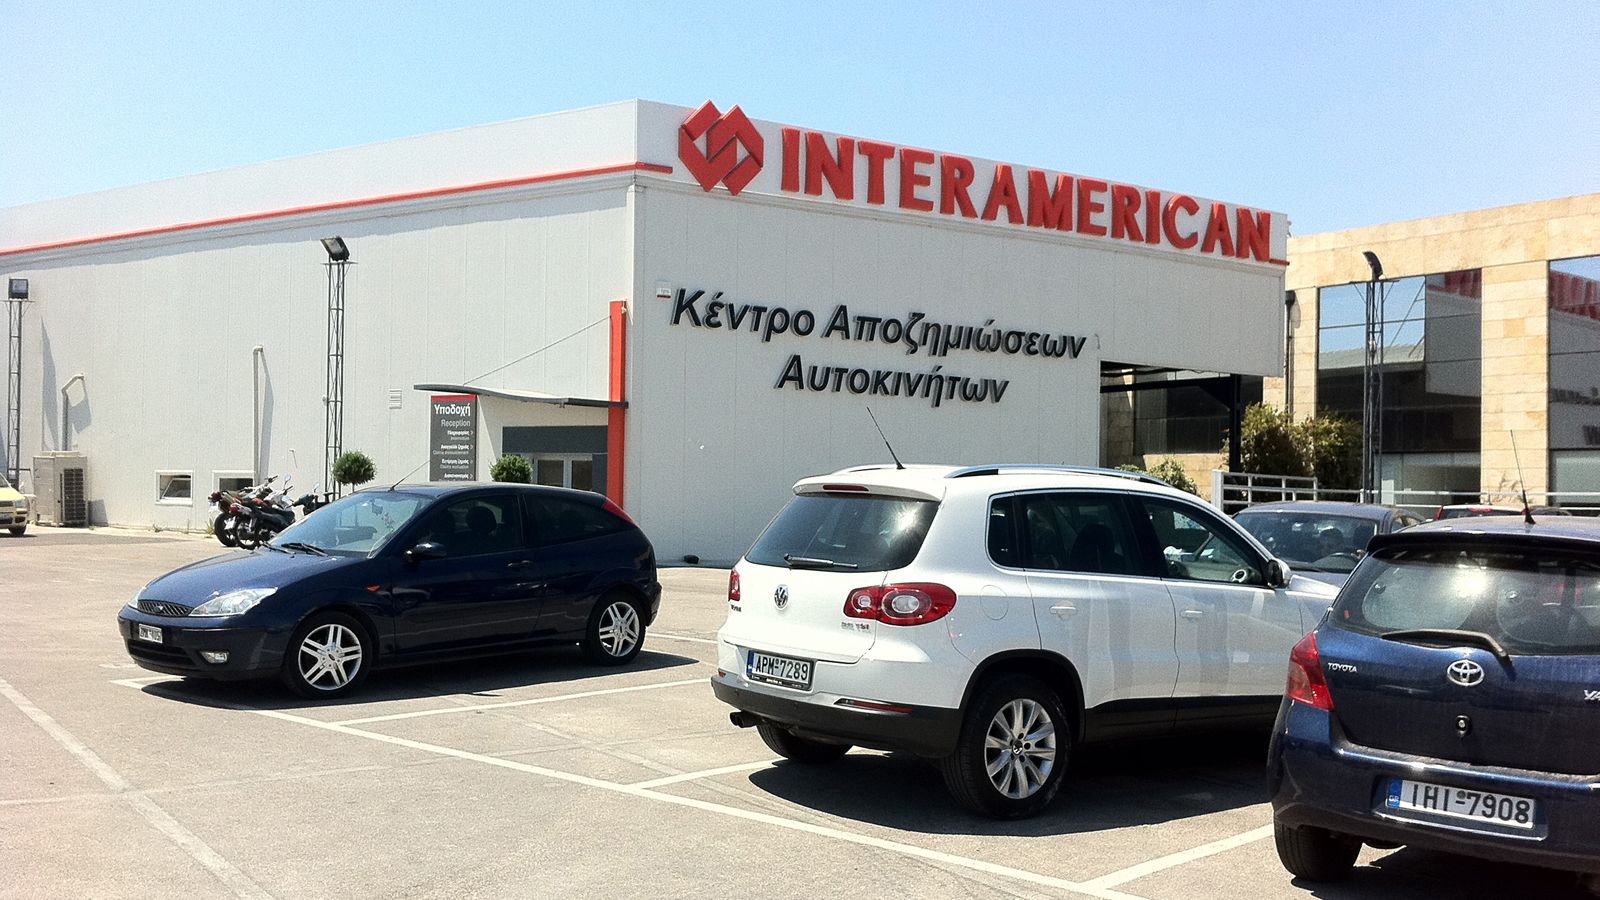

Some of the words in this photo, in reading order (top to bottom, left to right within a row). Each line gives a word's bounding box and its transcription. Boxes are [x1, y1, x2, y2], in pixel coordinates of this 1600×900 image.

[781, 127, 1271, 263] INTERAMERICAN
[670, 288, 815, 343] Κέντρο
[821, 304, 1087, 359] Αποζημιώσεων
[774, 354, 1010, 409] Αυτοκινήτων
[434, 403, 471, 417] Υποδοχή
[441, 419, 471, 429] Reception
[1327, 662, 1358, 673] TOYOTA
